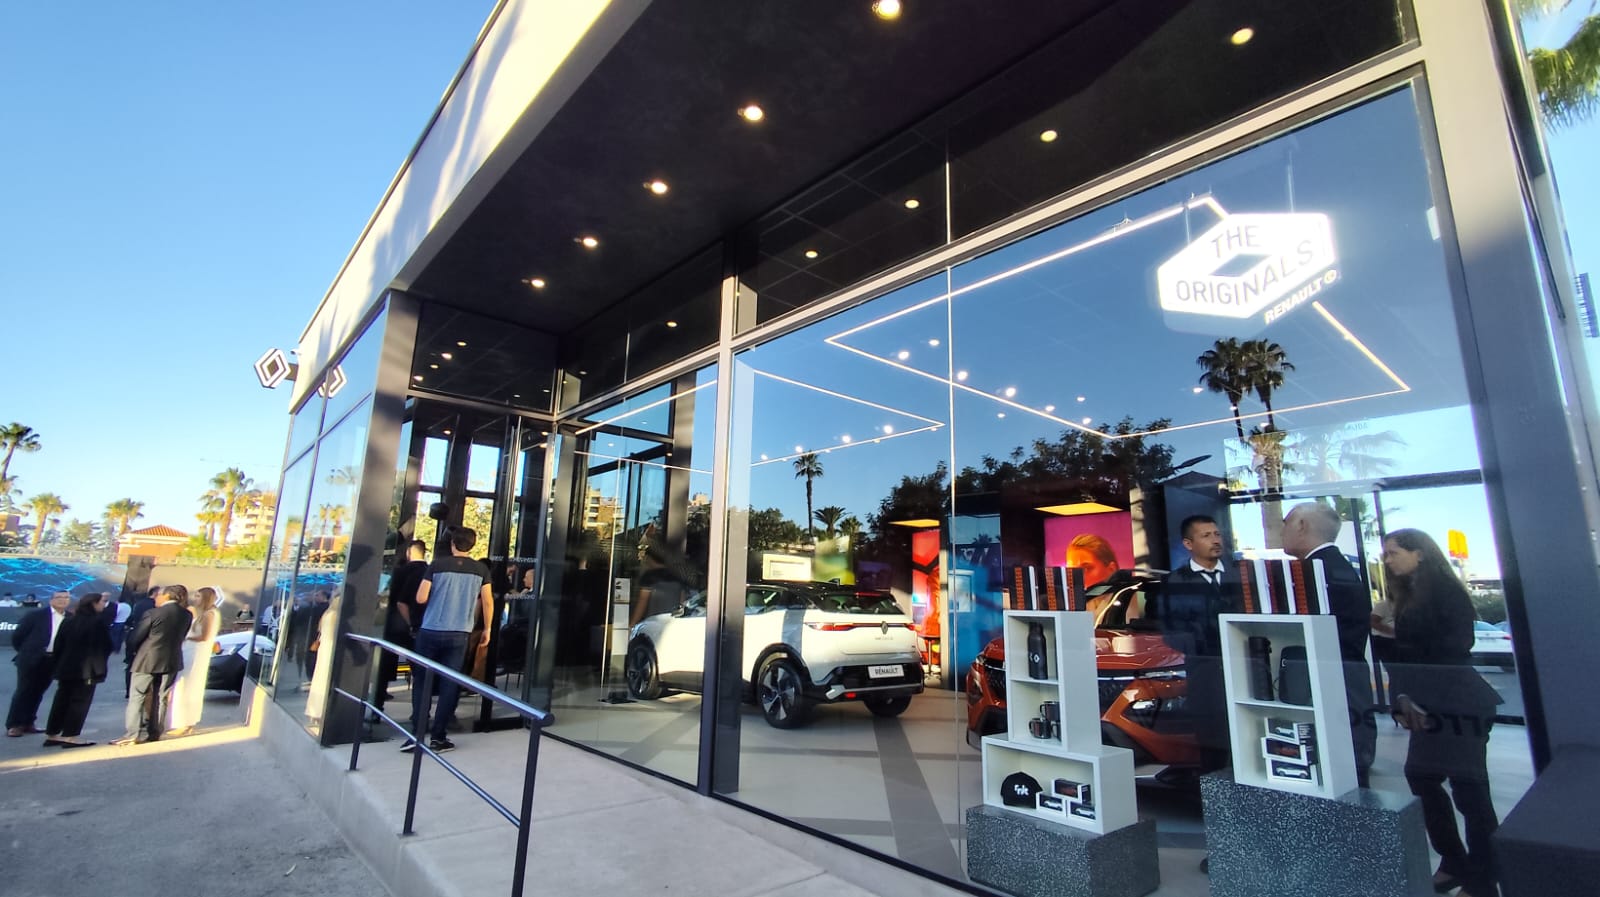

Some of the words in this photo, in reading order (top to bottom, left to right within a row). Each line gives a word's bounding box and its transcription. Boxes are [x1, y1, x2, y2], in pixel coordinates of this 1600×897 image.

[1210, 224, 1261, 259] THE
[1176, 239, 1314, 306] ORIGINALS
[1263, 277, 1323, 325] RENAULT
